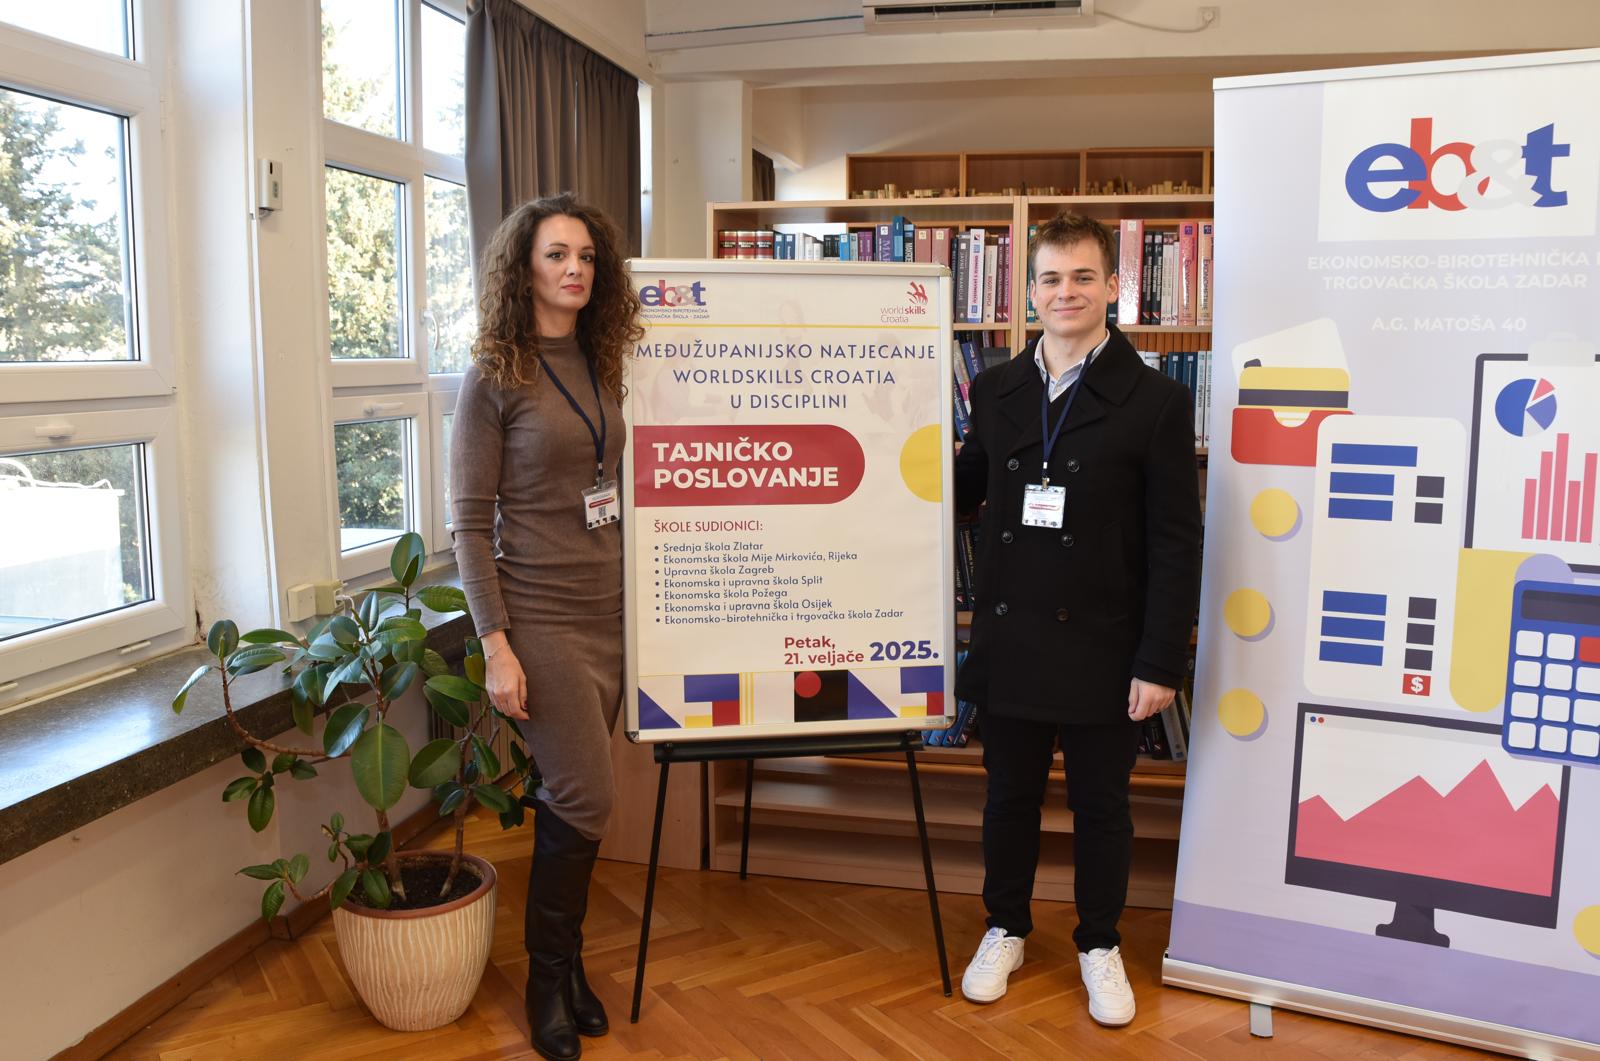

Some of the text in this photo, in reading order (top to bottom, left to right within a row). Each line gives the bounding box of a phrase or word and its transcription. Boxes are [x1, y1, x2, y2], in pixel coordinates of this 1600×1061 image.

[1307, 249, 1589, 270] EKONOMSKO-BIROTEHNIČKA
[1323, 272, 1586, 289] TRGOVAČKA ŠKOLA ZADAR
[880, 315, 909, 323] Croatia
[1371, 315, 1526, 331] A.G. MATOŠA 40
[636, 339, 935, 360] MEĐUŽUPANIJSKO NATJECANJE
[673, 370, 895, 384] WORLDSKILLS CROATIA
[731, 395, 846, 408] U DISCIPLINI
[652, 437, 792, 462] TAJNIČKO
[655, 467, 838, 488] POSLOVANJE
[655, 520, 762, 532] ŠKOLE SUDIONICI:
[664, 542, 763, 554] Srednja škola Zlatar
[664, 552, 857, 564] Ekonomska škola Mije Mirkovića, Rijeka
[664, 564, 774, 578] Upravna škola Zagreb
[665, 576, 822, 590] Ekonomska i upravna škola Split
[665, 588, 787, 600] Ekonomska škola Požega
[665, 599, 833, 614] Ekonomska i upravna škola Osijek
[665, 612, 787, 624] Ekonomsko-birotehnička
[797, 610, 844, 623] trgovačka
[848, 610, 872, 619] škola
[875, 609, 903, 618] Zadar
[785, 636, 835, 649] Petak,
[784, 640, 939, 666] 21. veljače 2025.
